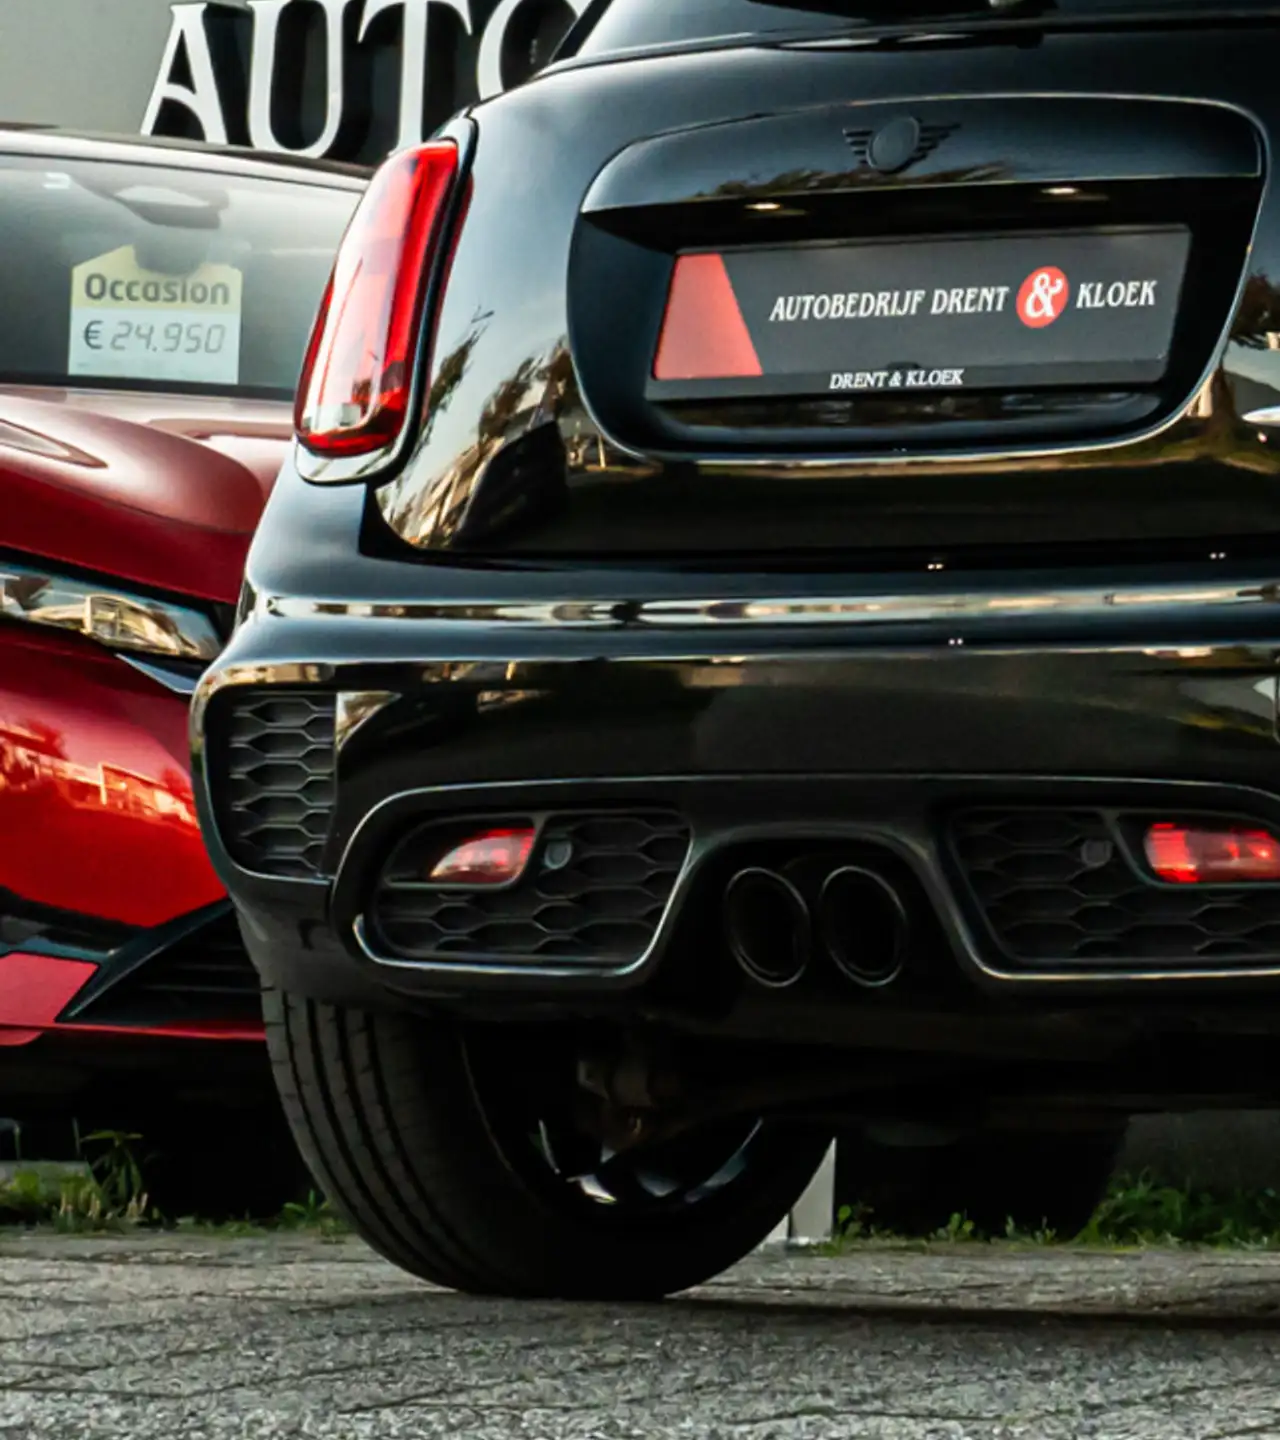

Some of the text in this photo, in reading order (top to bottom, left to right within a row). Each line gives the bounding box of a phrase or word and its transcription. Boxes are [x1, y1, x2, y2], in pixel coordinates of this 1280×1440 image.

[85, 273, 230, 305] Occasion
[768, 271, 1158, 322] AUTOBEDRIJF DRENT & KLOEK
[109, 320, 226, 354] 24.950
[829, 368, 965, 390] DRENT & KLOEK
